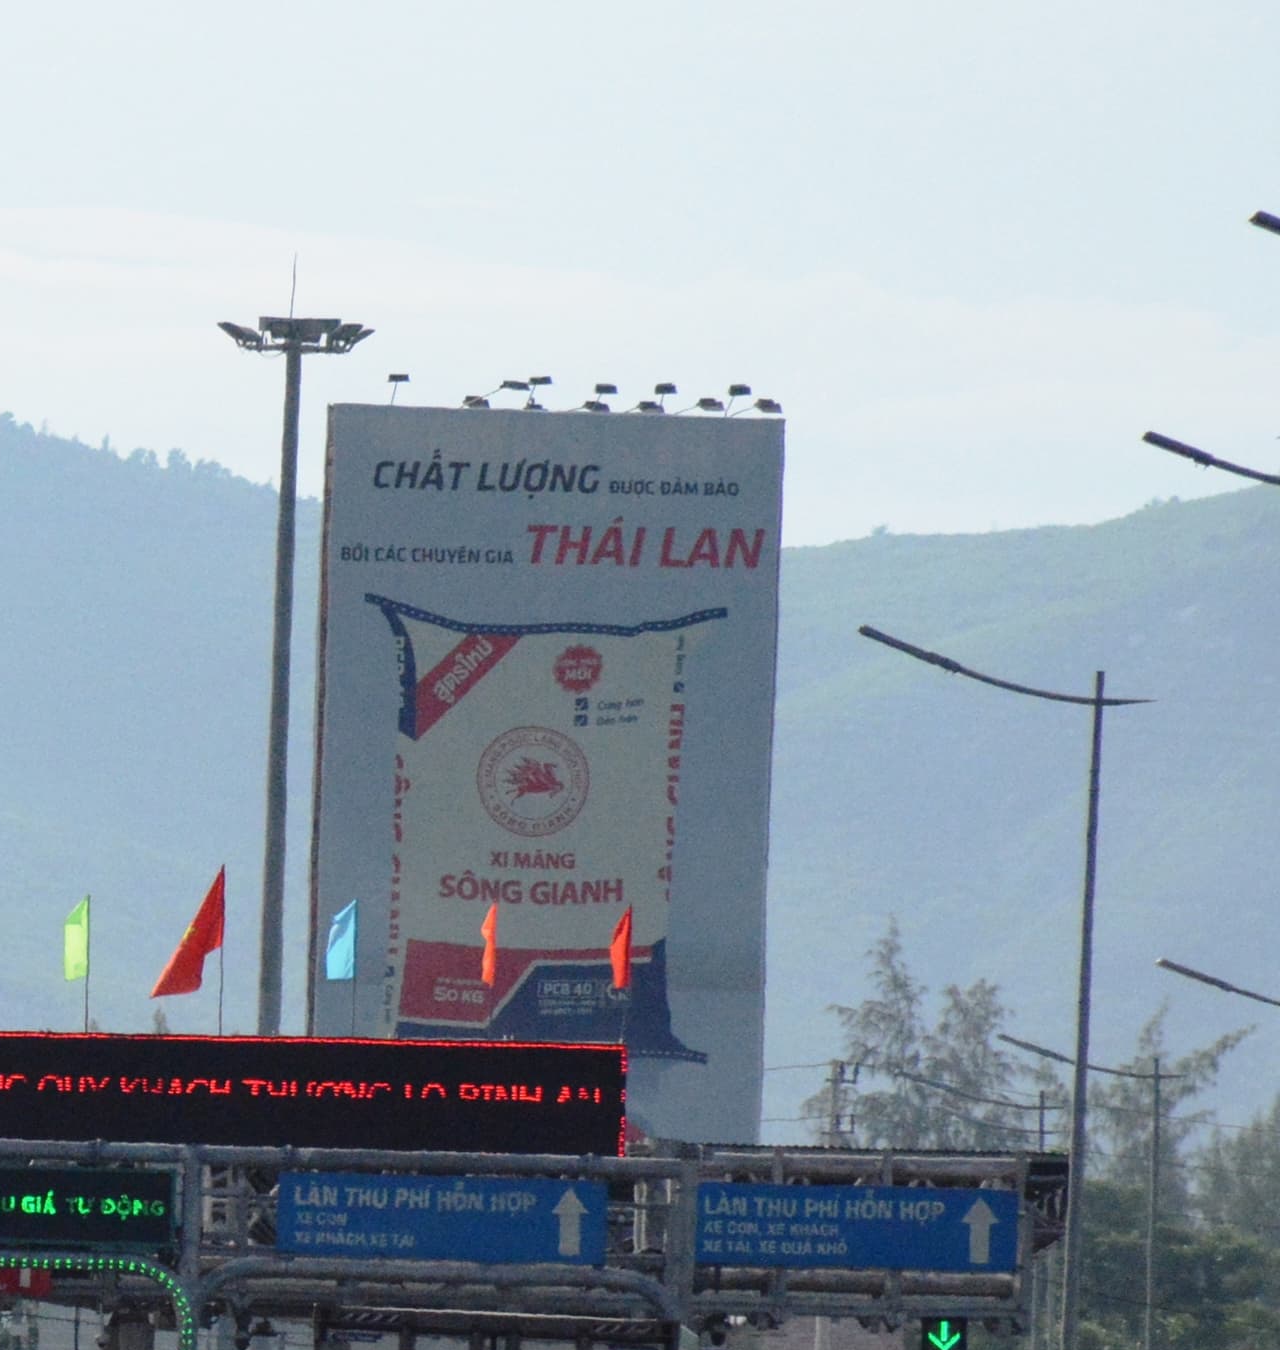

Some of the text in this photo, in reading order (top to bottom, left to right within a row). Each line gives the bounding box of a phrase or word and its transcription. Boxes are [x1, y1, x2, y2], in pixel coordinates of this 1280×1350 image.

[373, 449, 470, 491] CHẤT
[477, 458, 600, 499] LƯỢNG
[375, 545, 406, 563] CÁC
[485, 550, 514, 565] GIA
[527, 515, 647, 568] THÁI
[660, 527, 767, 570] LAN
[490, 851, 509, 868] XI
[440, 870, 624, 906] SÔNG GIANH
[20, 1190, 58, 1216] GIÁ
[294, 1182, 338, 1207] LÀN
[344, 1187, 389, 1209] THU
[394, 1185, 432, 1210] PHÍ
[704, 1192, 747, 1216] LÀN
[753, 1198, 797, 1218] THU
[804, 1193, 842, 1219] PHÍ
